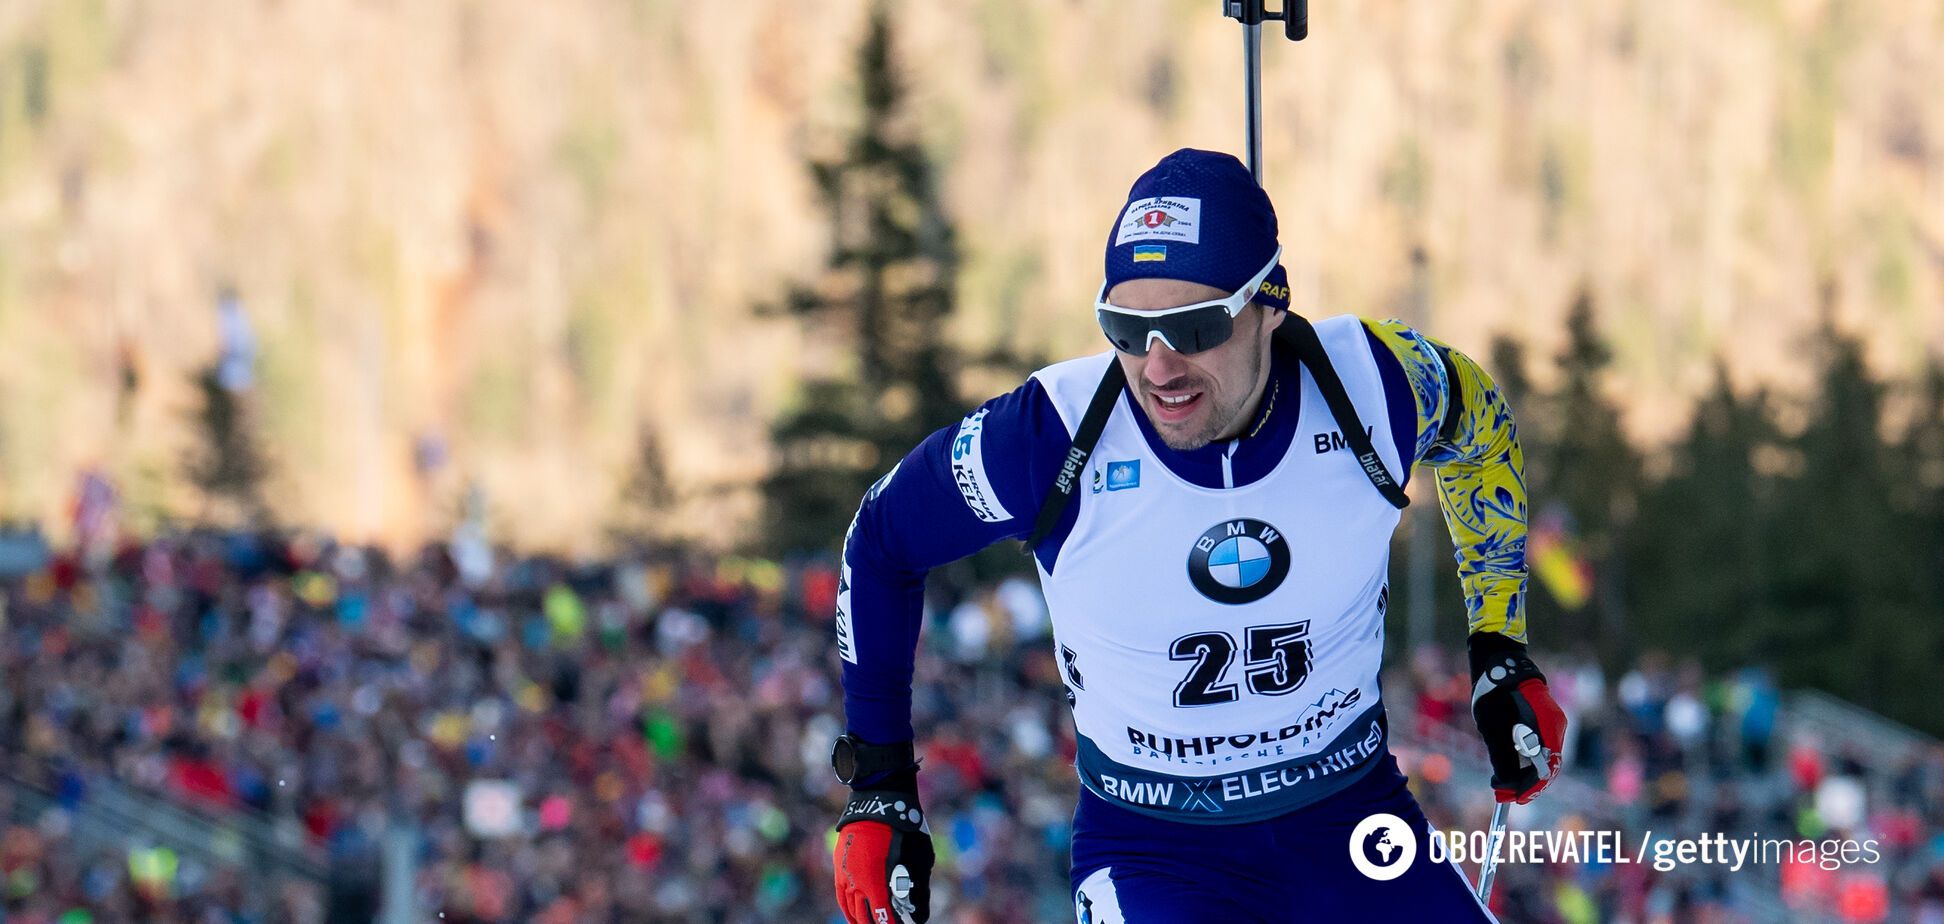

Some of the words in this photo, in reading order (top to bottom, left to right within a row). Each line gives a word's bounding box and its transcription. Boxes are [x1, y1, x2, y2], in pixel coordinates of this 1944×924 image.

[1148, 212, 1159, 225] 1
[1260, 281, 1291, 300] RAF
[1055, 446, 1087, 493] biatar
[1359, 452, 1390, 487] biatar
[953, 464, 988, 520] KELA
[967, 466, 999, 520] TERCIUM
[1196, 520, 1280, 553] BMW
[1168, 618, 1314, 709] 25
[1126, 687, 1362, 759] RUHPOLDING
[1100, 773, 1175, 807] BMW
